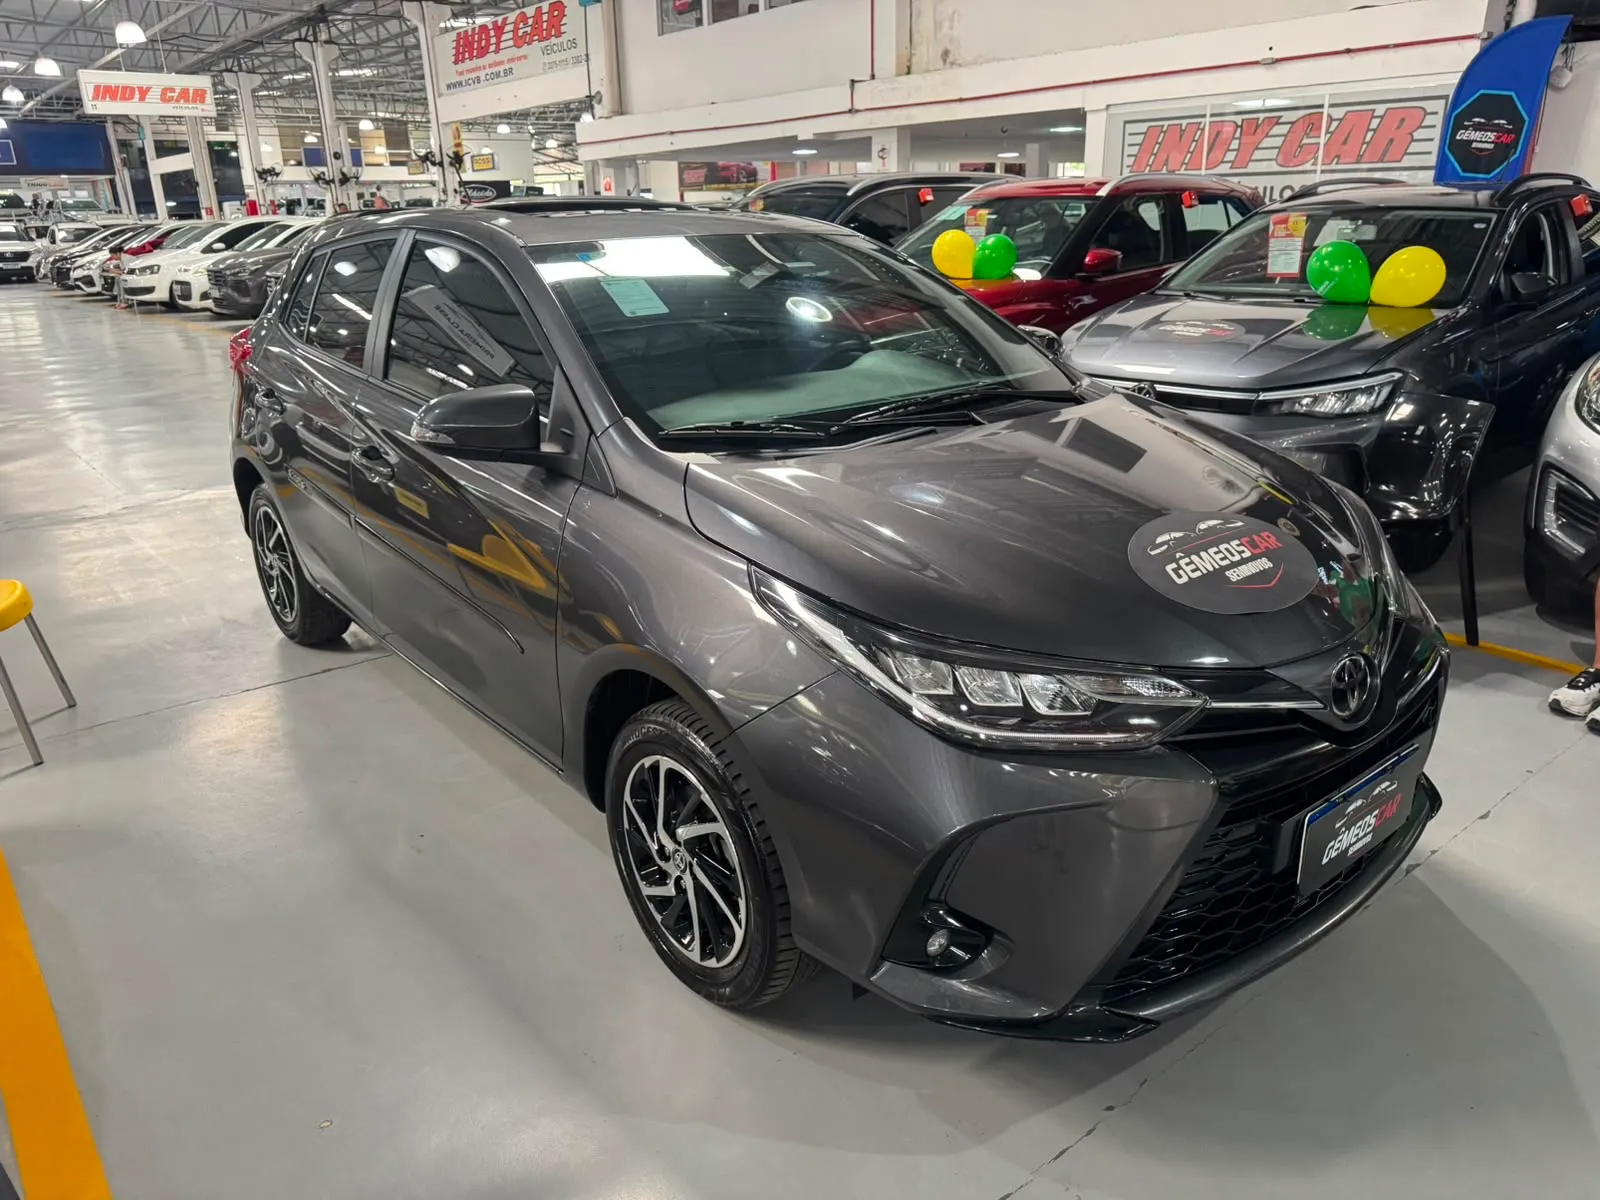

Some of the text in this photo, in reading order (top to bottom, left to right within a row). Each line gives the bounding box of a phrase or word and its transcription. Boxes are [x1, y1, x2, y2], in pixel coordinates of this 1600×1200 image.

[454, 16, 509, 66] INDY
[513, 0, 566, 48] CAR
[92, 85, 208, 104] INDY CAR
[1130, 106, 1427, 173] INDY CAR
[1165, 531, 1283, 585] GÊMEOSCAR
[1225, 557, 1274, 583] SEMINOVOS
[1322, 793, 1404, 865] GÊMEOSCAR
